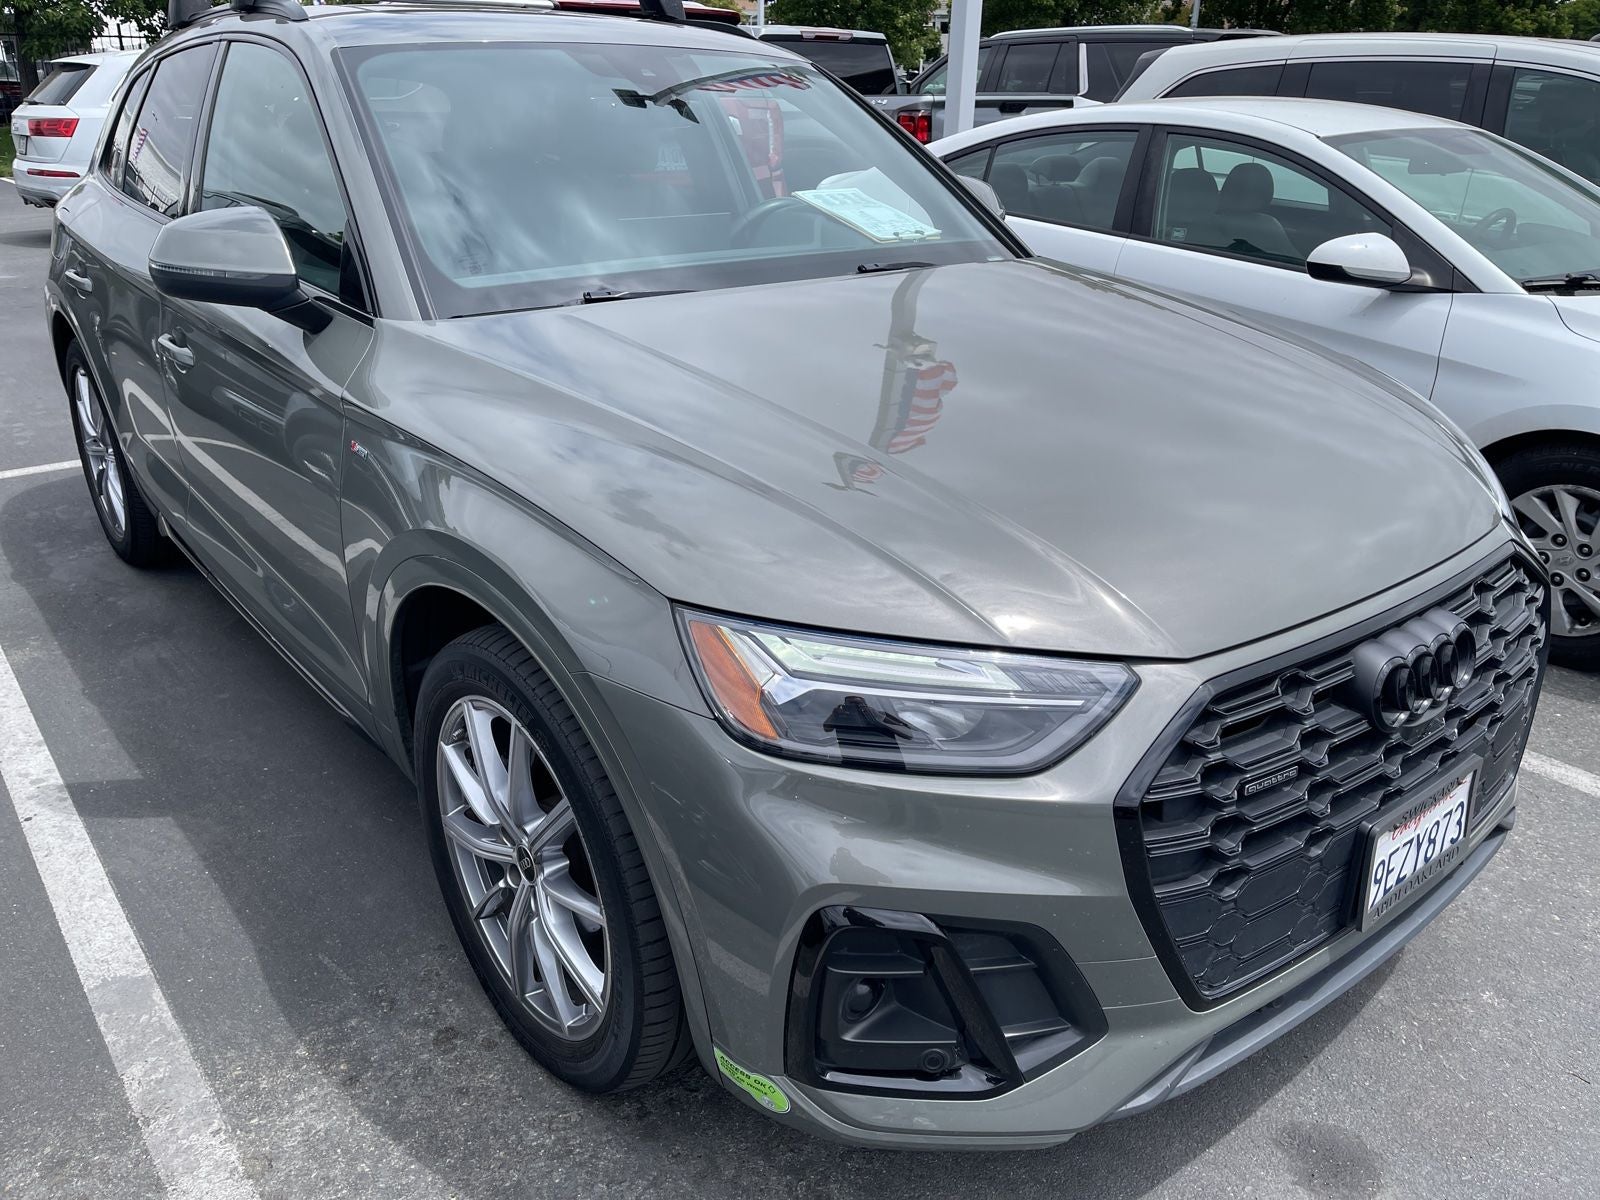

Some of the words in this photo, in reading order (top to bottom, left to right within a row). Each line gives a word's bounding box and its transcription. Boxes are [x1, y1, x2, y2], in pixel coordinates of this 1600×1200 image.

[1248, 769, 1297, 793] quattro
[1370, 800, 1465, 910] 9EZY873
[1404, 846, 1460, 895] OAKLAND
[720, 1055, 751, 1080] ACCESS
[753, 1079, 767, 1088] OK
